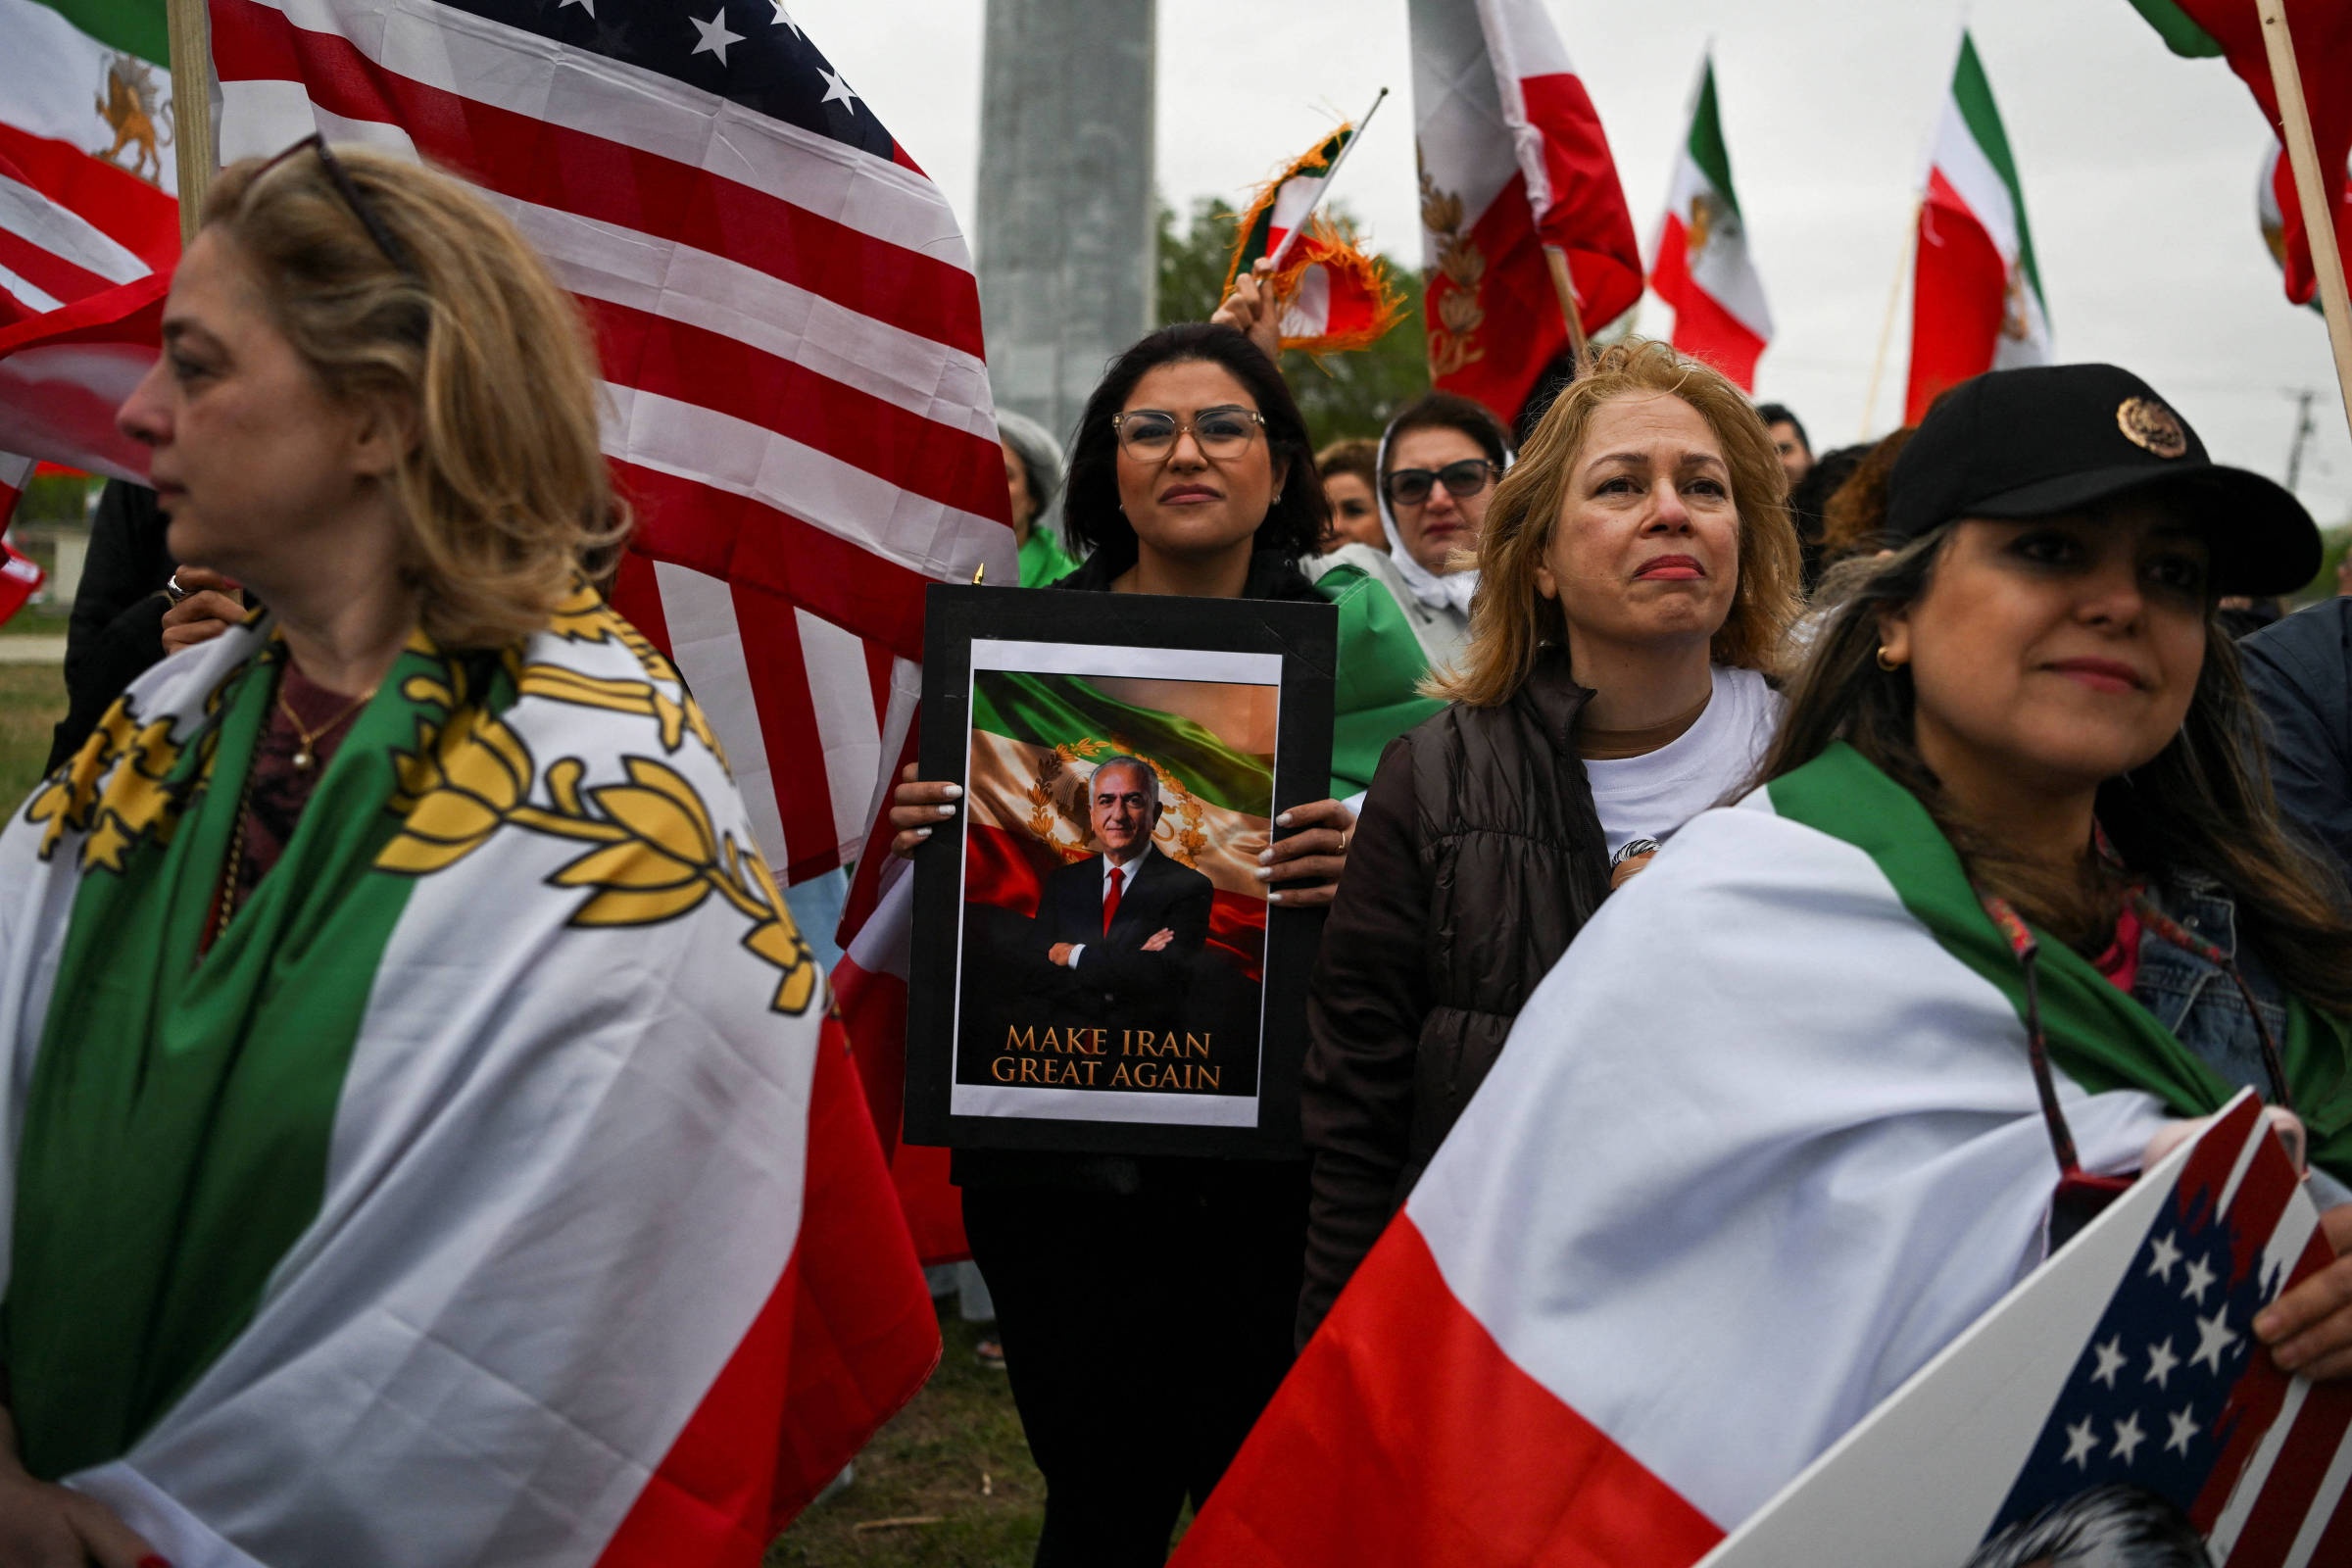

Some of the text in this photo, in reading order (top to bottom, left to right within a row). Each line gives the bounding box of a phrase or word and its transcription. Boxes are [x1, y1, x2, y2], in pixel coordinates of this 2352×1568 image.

[1004, 1024, 1211, 1058] MAKE IRAN
[991, 1055, 1222, 1090] GREAT AGAIN
